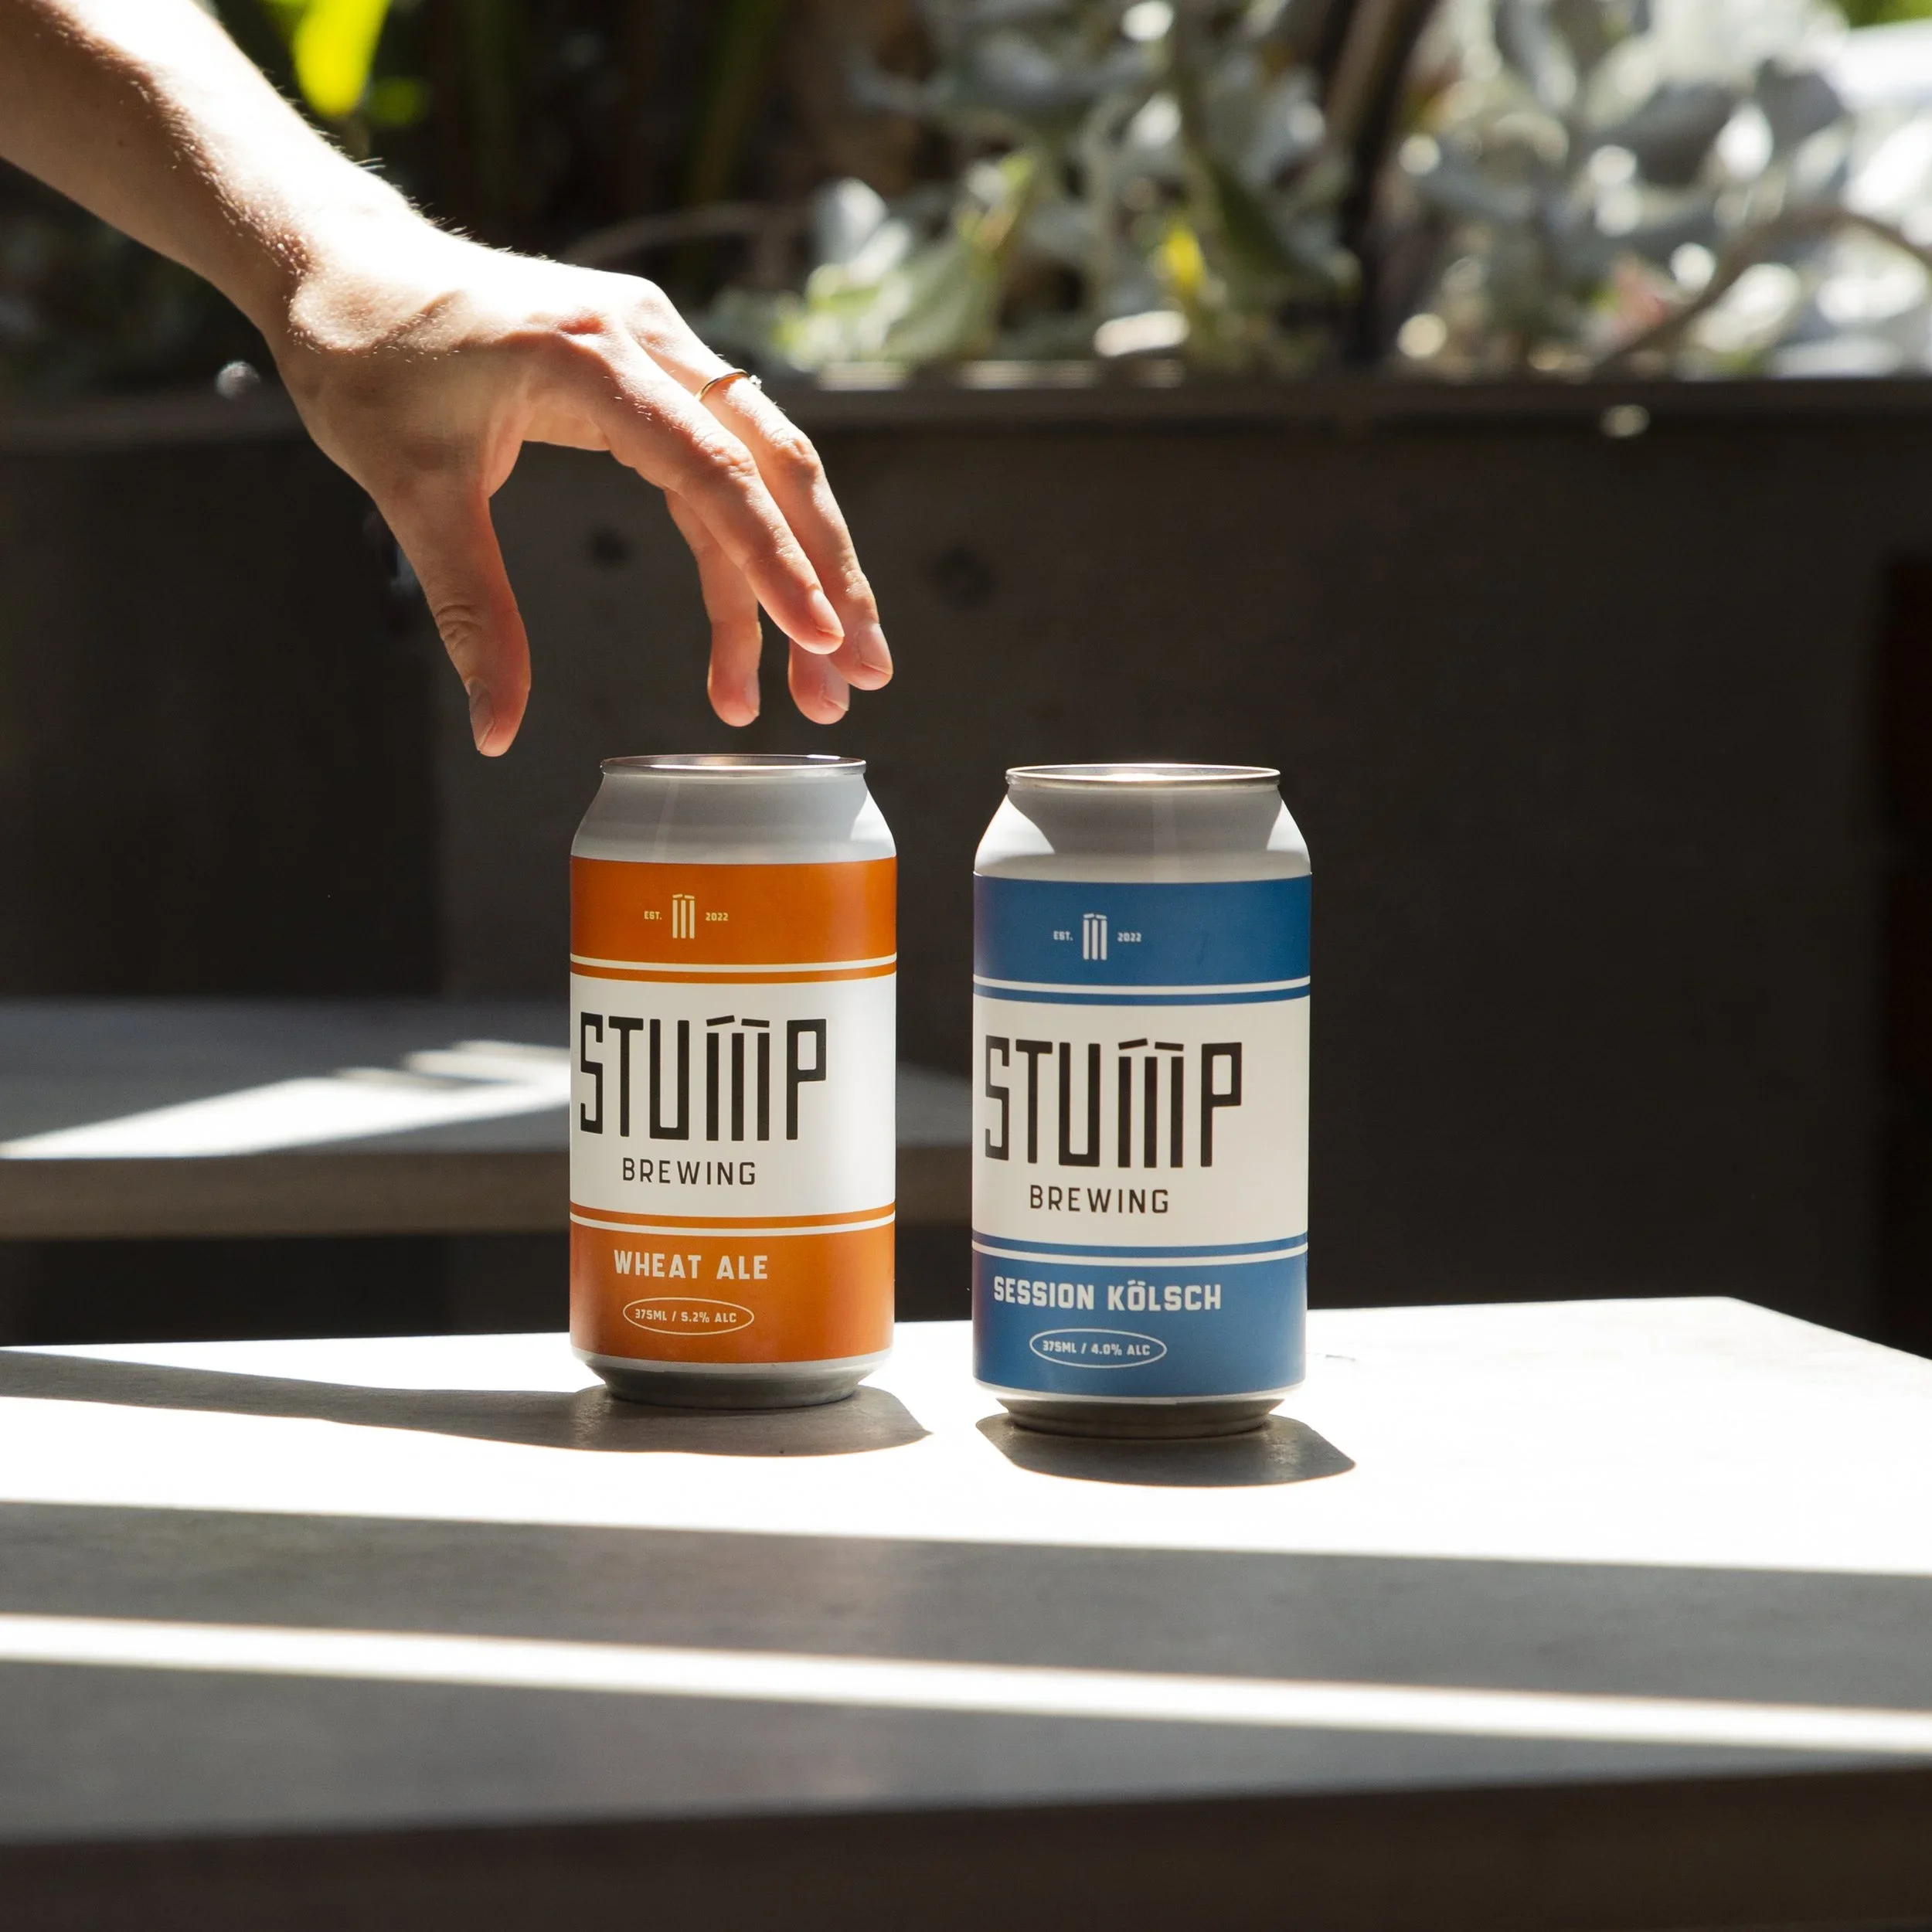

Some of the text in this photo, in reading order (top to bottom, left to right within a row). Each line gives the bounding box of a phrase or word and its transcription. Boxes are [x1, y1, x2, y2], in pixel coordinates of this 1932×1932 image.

[644, 910, 729, 922] EST. 2022
[1053, 930, 1141, 943] EST. 2022
[580, 1011, 827, 1141] STUMP
[985, 1034, 1242, 1168] STUMP
[622, 1157, 756, 1185] BREWING
[1029, 1185, 1168, 1213] BREWING
[614, 1249, 768, 1280] WHEAT ALE
[994, 1275, 1221, 1311] SESSION KÖLSCH
[635, 1308, 737, 1323] 375ML / 5.2% ALC
[1043, 1340, 1151, 1356] 375ML / 4.0% ALC
